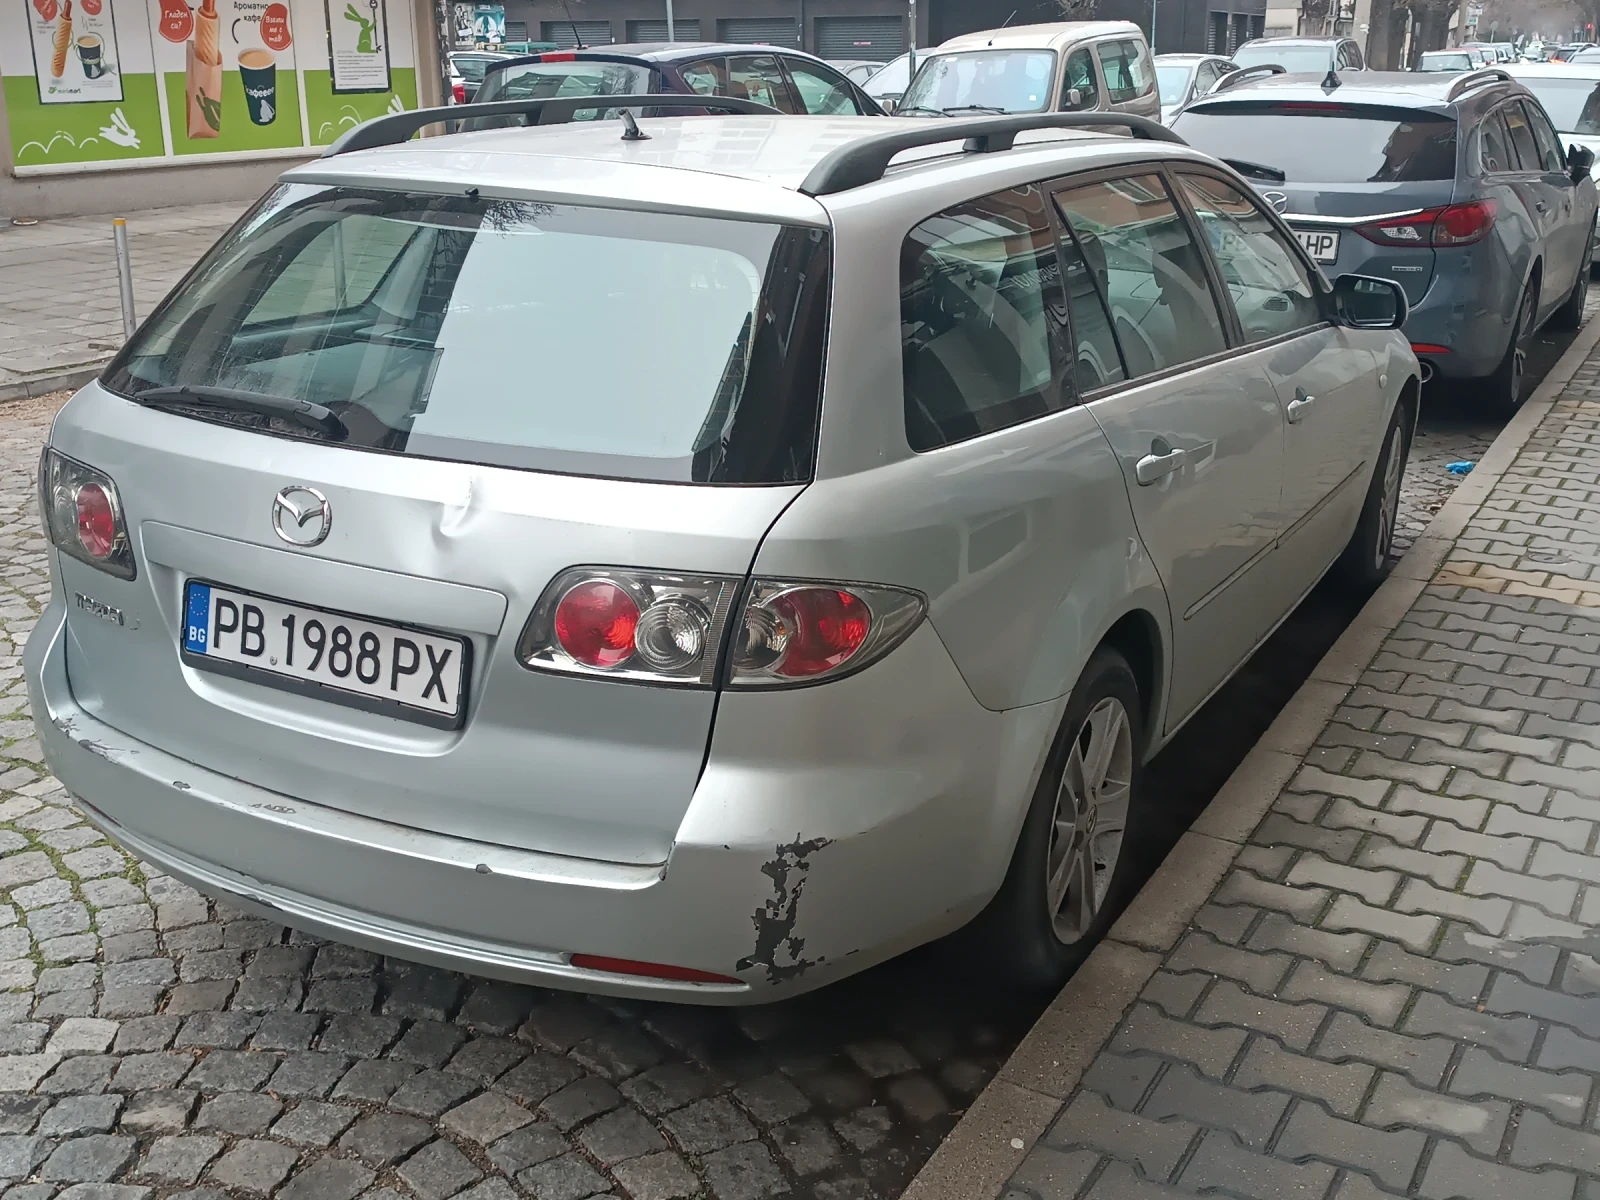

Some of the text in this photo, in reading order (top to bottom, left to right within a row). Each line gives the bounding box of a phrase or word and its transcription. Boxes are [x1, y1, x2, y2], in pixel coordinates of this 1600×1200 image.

[164, 9, 189, 19] Гладен
[243, 14, 262, 24] кафе
[170, 21, 182, 30] си?
[1306, 235, 1333, 255] HP
[188, 625, 206, 643] BG
[213, 597, 454, 705] PB 1988 PX
